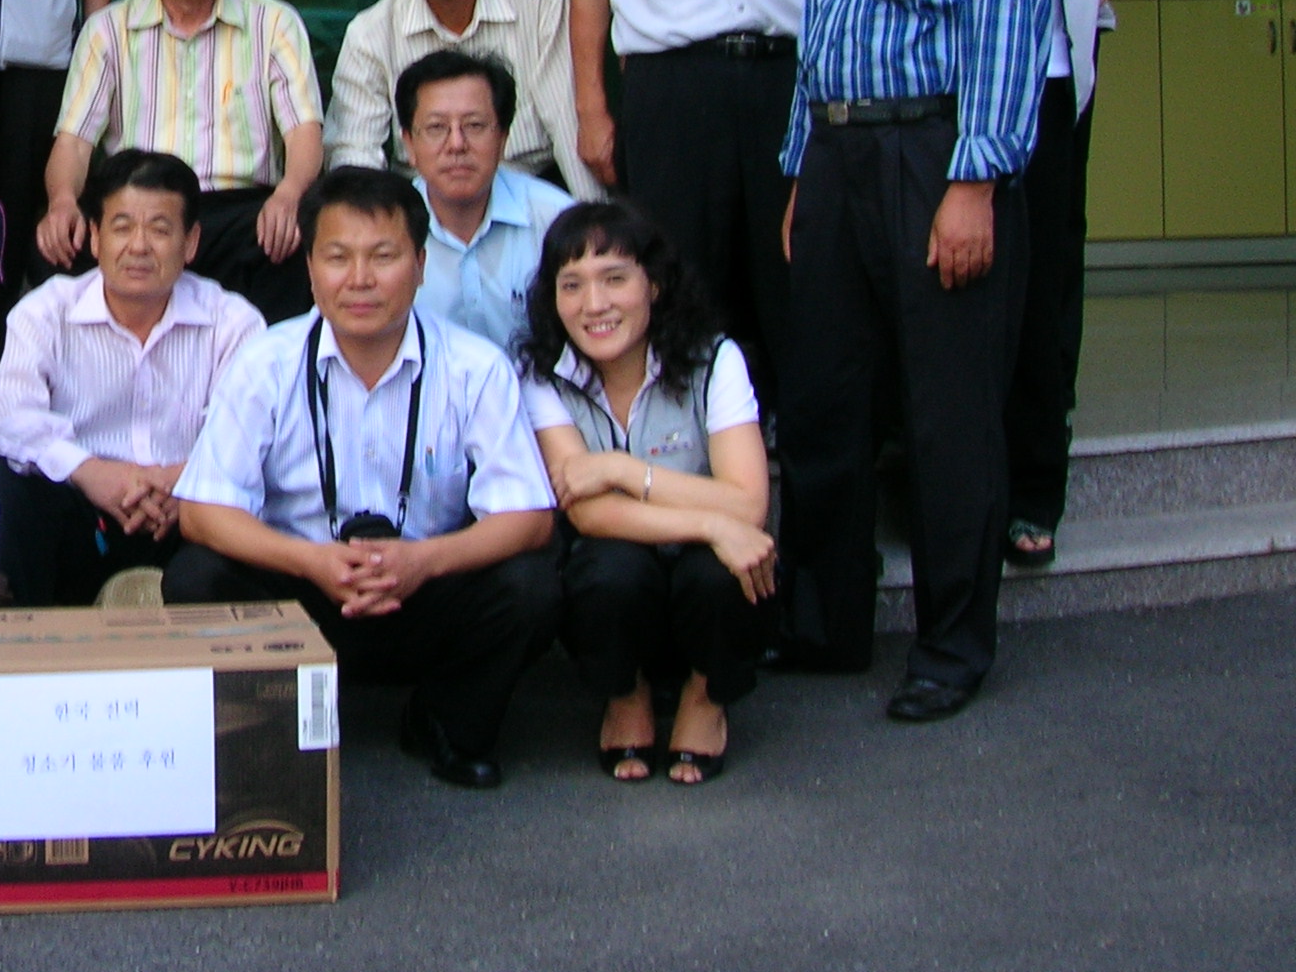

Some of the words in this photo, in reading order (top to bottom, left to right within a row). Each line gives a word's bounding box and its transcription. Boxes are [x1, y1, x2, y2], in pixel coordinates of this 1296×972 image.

[55, 699, 91, 722] 한국
[24, 749, 77, 774] 청소기
[169, 833, 304, 862] CYKING
